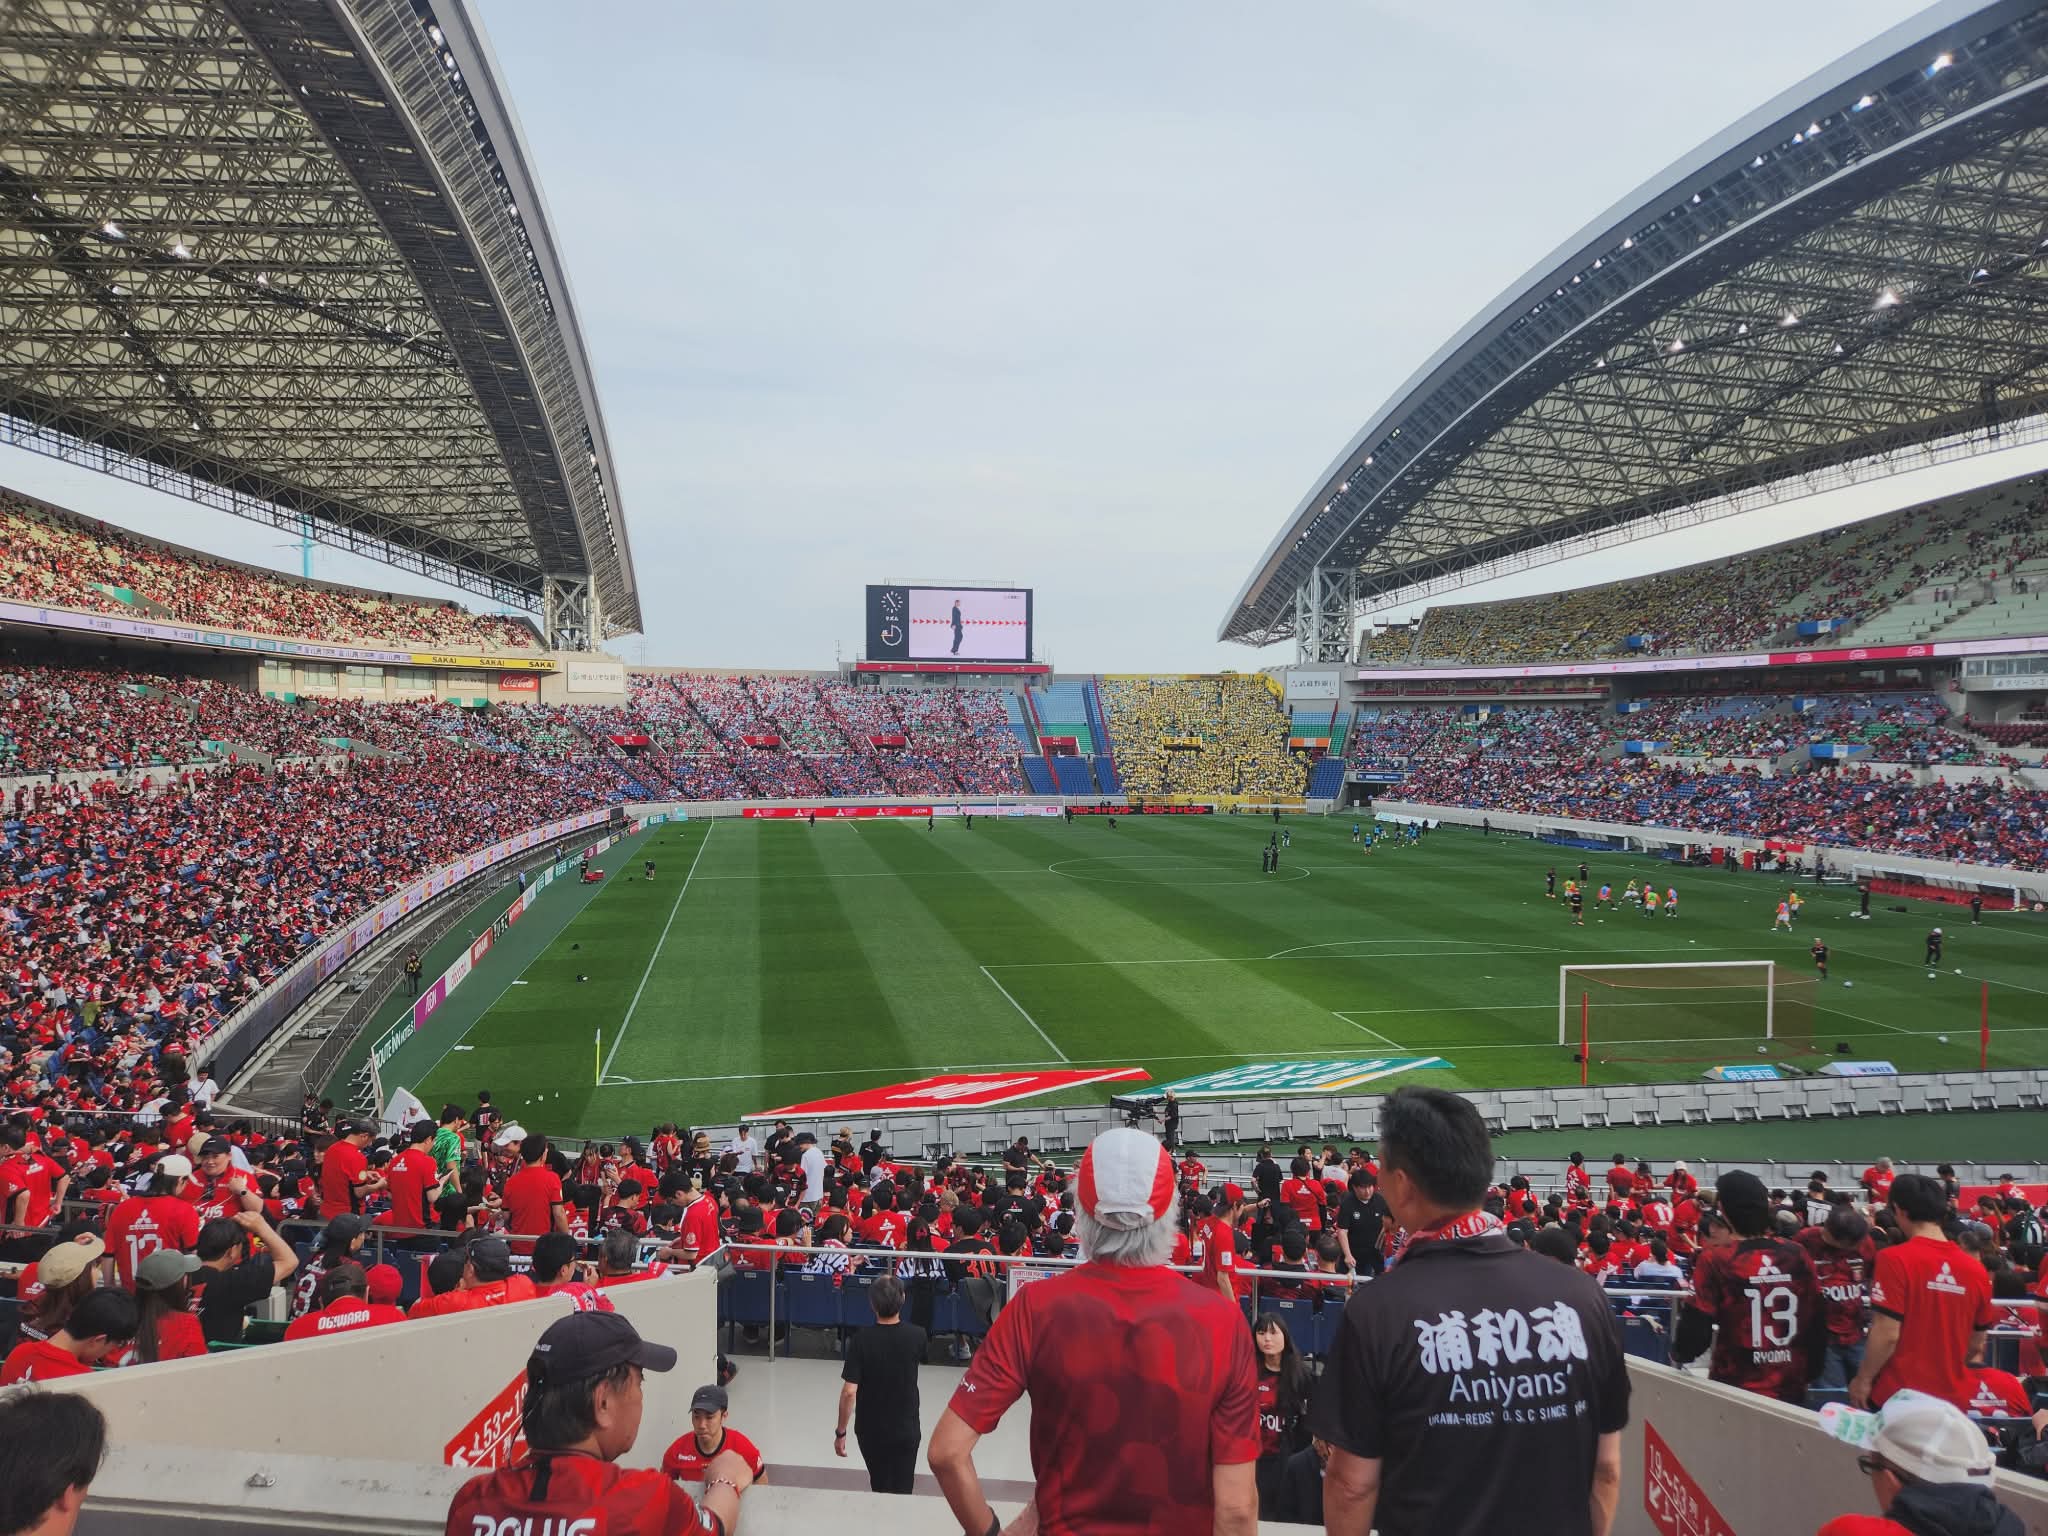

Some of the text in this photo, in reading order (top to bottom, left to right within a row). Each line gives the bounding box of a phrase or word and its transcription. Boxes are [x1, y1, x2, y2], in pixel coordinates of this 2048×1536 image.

[432, 656, 457, 664] SAKAI
[1743, 1286, 1798, 1348] 13
[1413, 1300, 1589, 1375] 浦和魂
[1539, 1403, 1568, 1420] SINCE
